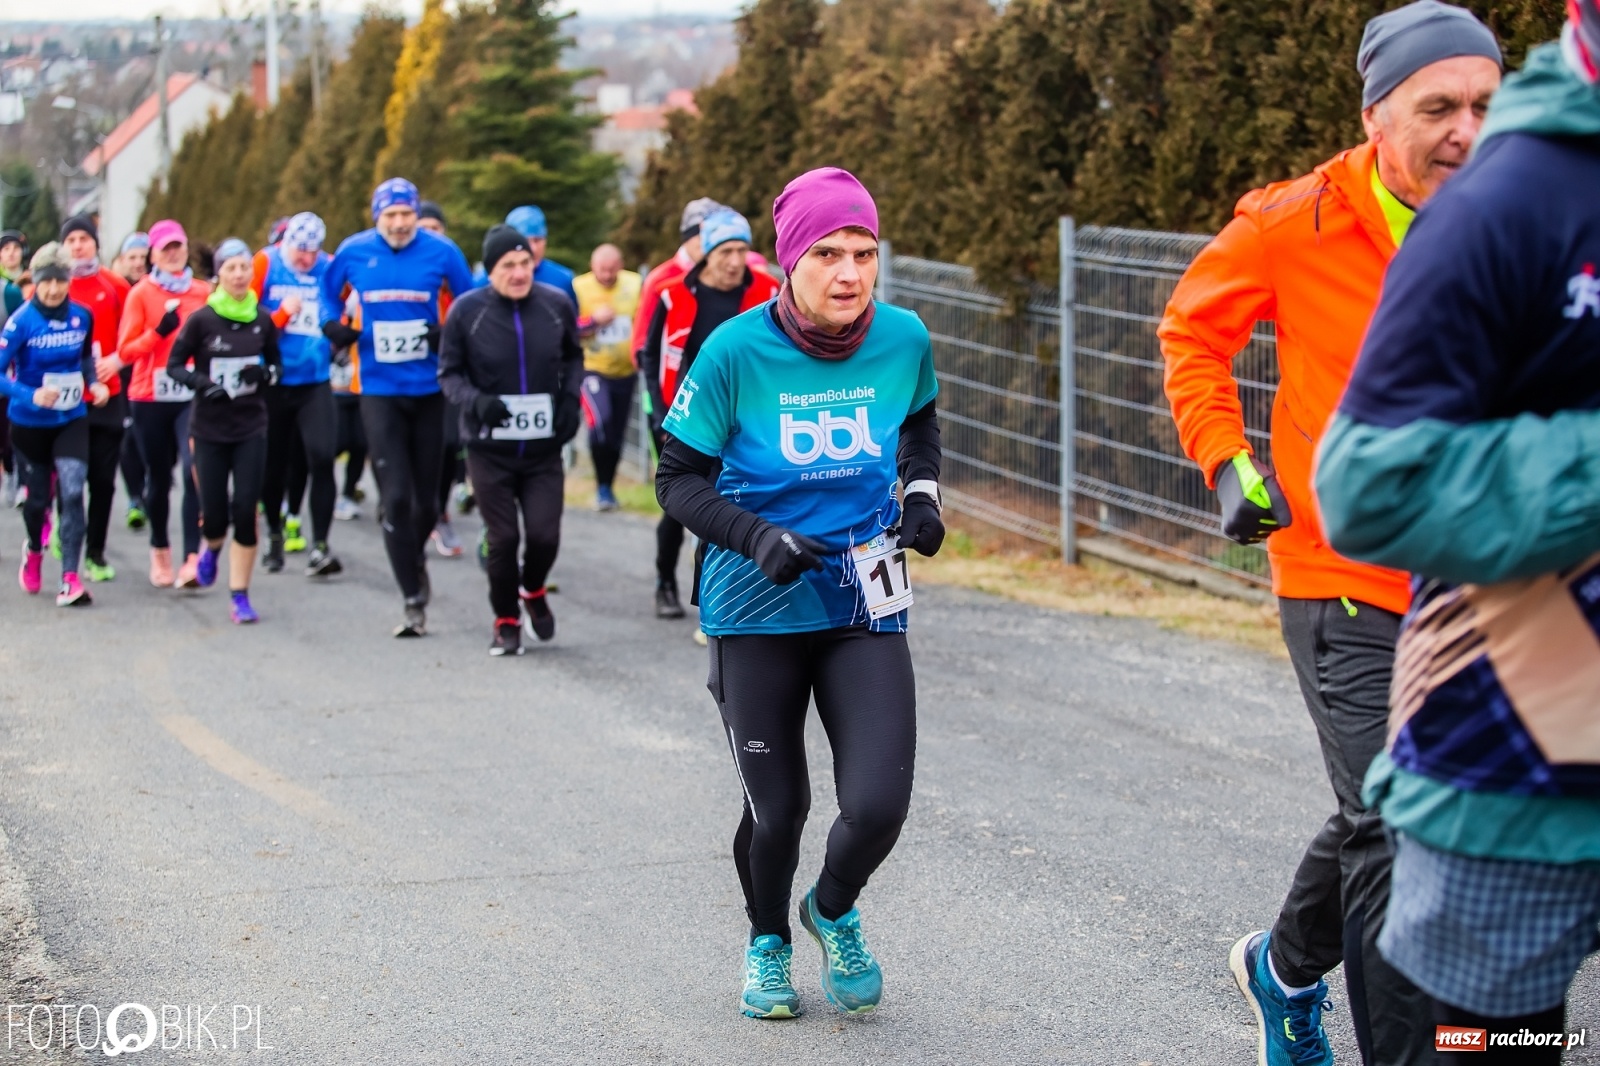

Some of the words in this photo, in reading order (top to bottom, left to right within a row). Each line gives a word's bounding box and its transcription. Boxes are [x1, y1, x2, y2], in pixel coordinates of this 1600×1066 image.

[380, 336, 424, 353] 322
[62, 385, 81, 403] 70
[779, 386, 875, 407] BiegamBoLubię
[779, 406, 882, 466] bbl
[801, 467, 863, 481] RACIBÓRZ
[869, 550, 908, 598] 17
